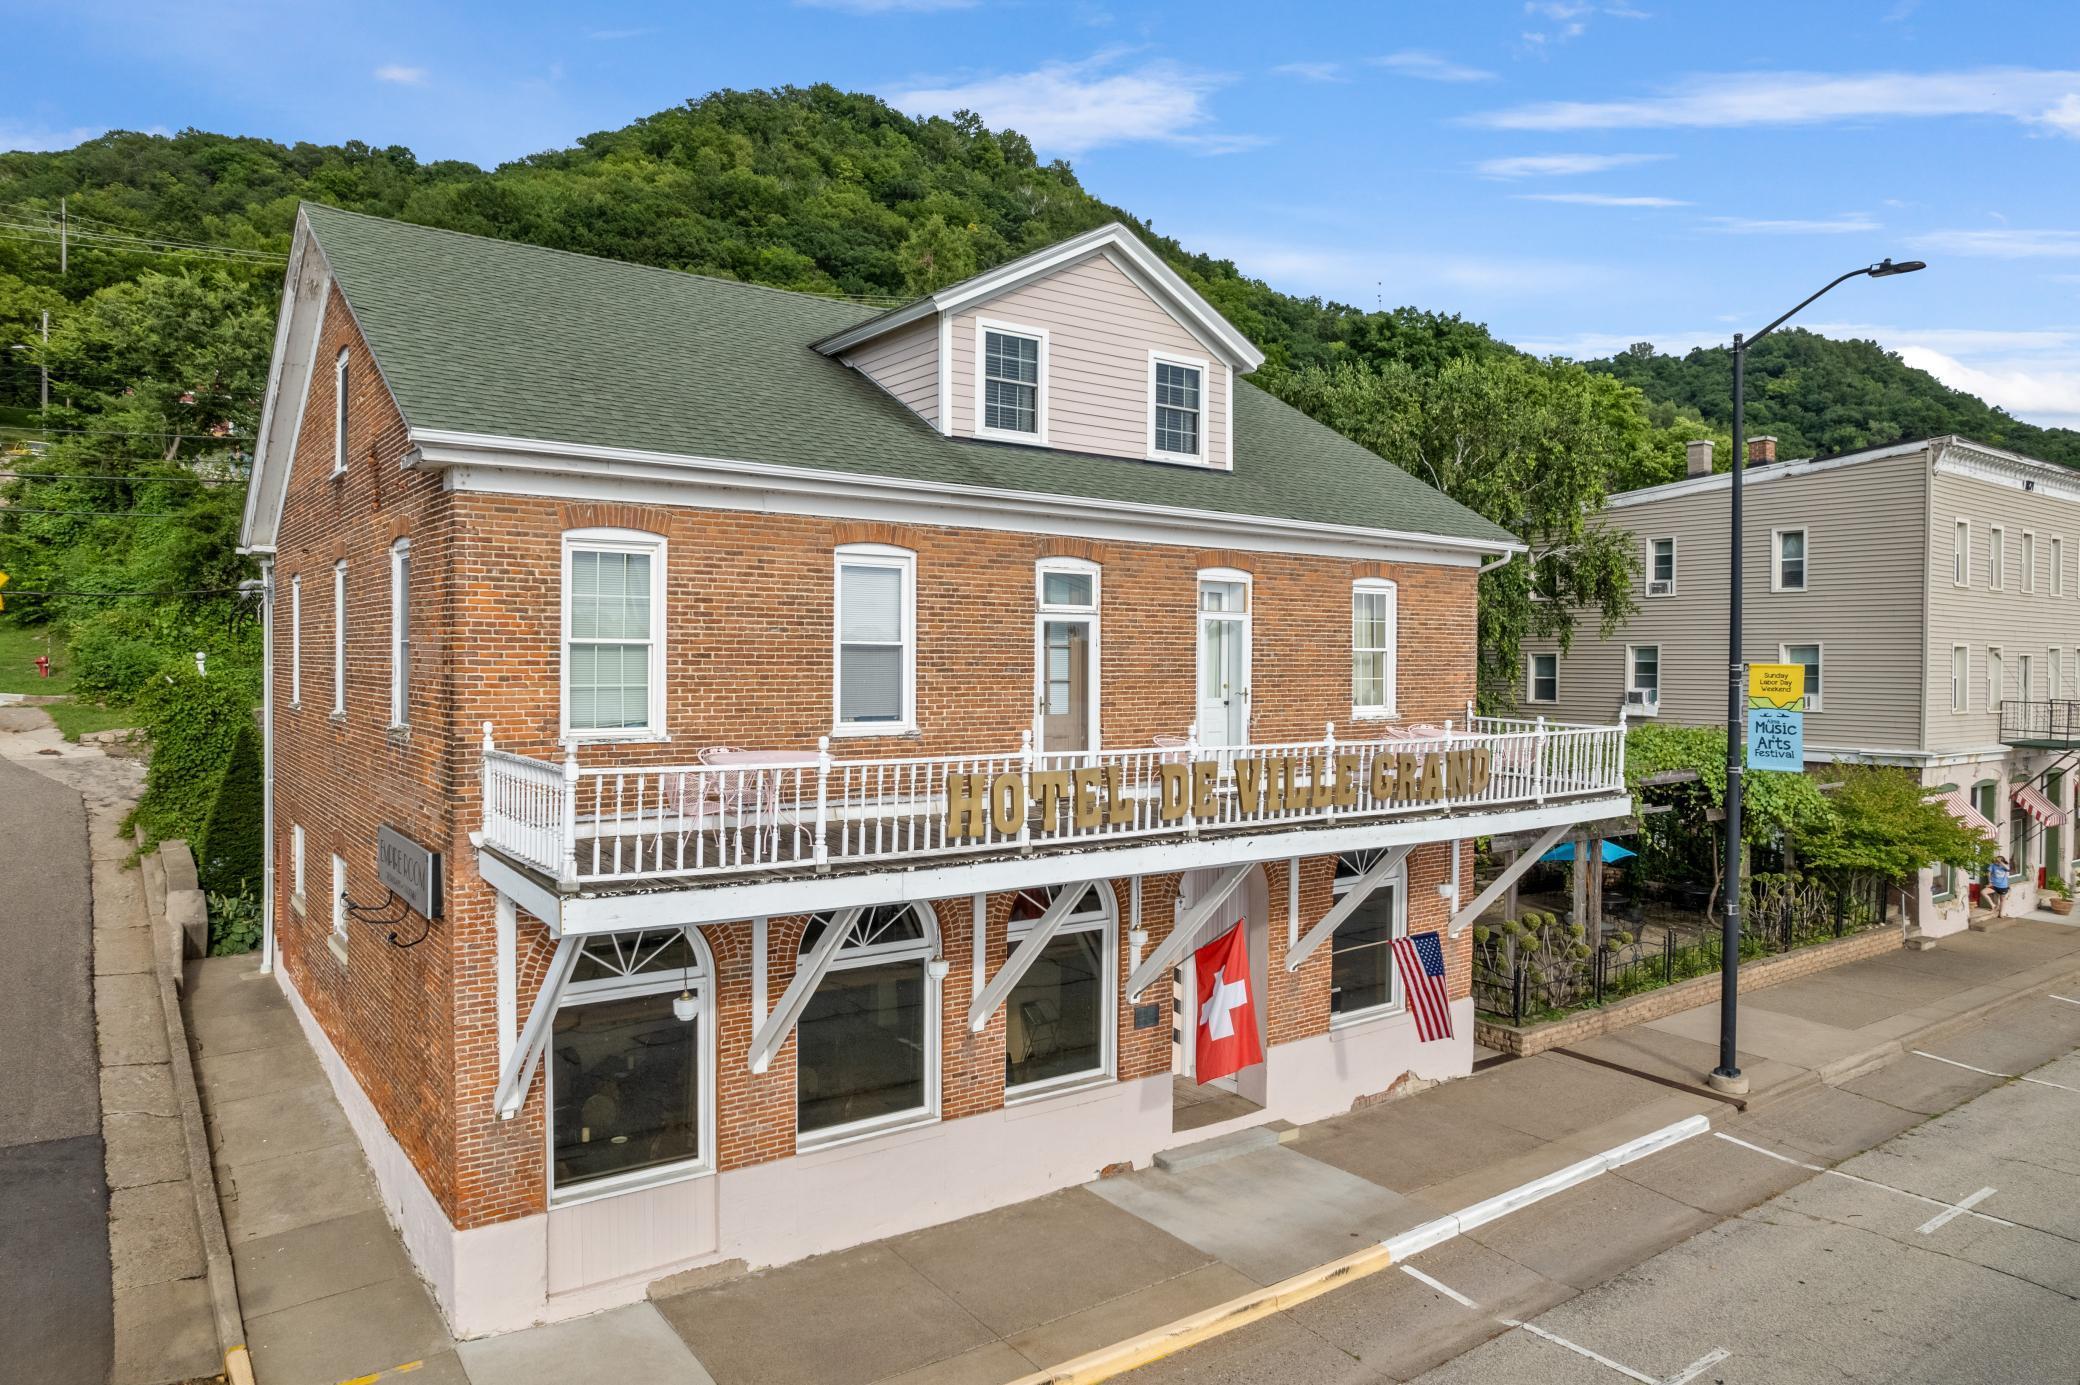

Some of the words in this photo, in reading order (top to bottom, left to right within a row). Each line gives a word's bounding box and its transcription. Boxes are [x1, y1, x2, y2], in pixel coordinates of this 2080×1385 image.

[1764, 672, 1789, 680] Sunday
[1755, 721, 1798, 735] Music
[1757, 736, 1791, 750] Arts
[1754, 748, 1795, 759] Festival
[946, 763, 1137, 837] HOTEL
[1159, 760, 1219, 820] DE
[1234, 753, 1362, 813] VILLE
[1370, 747, 1490, 801] GRAND
